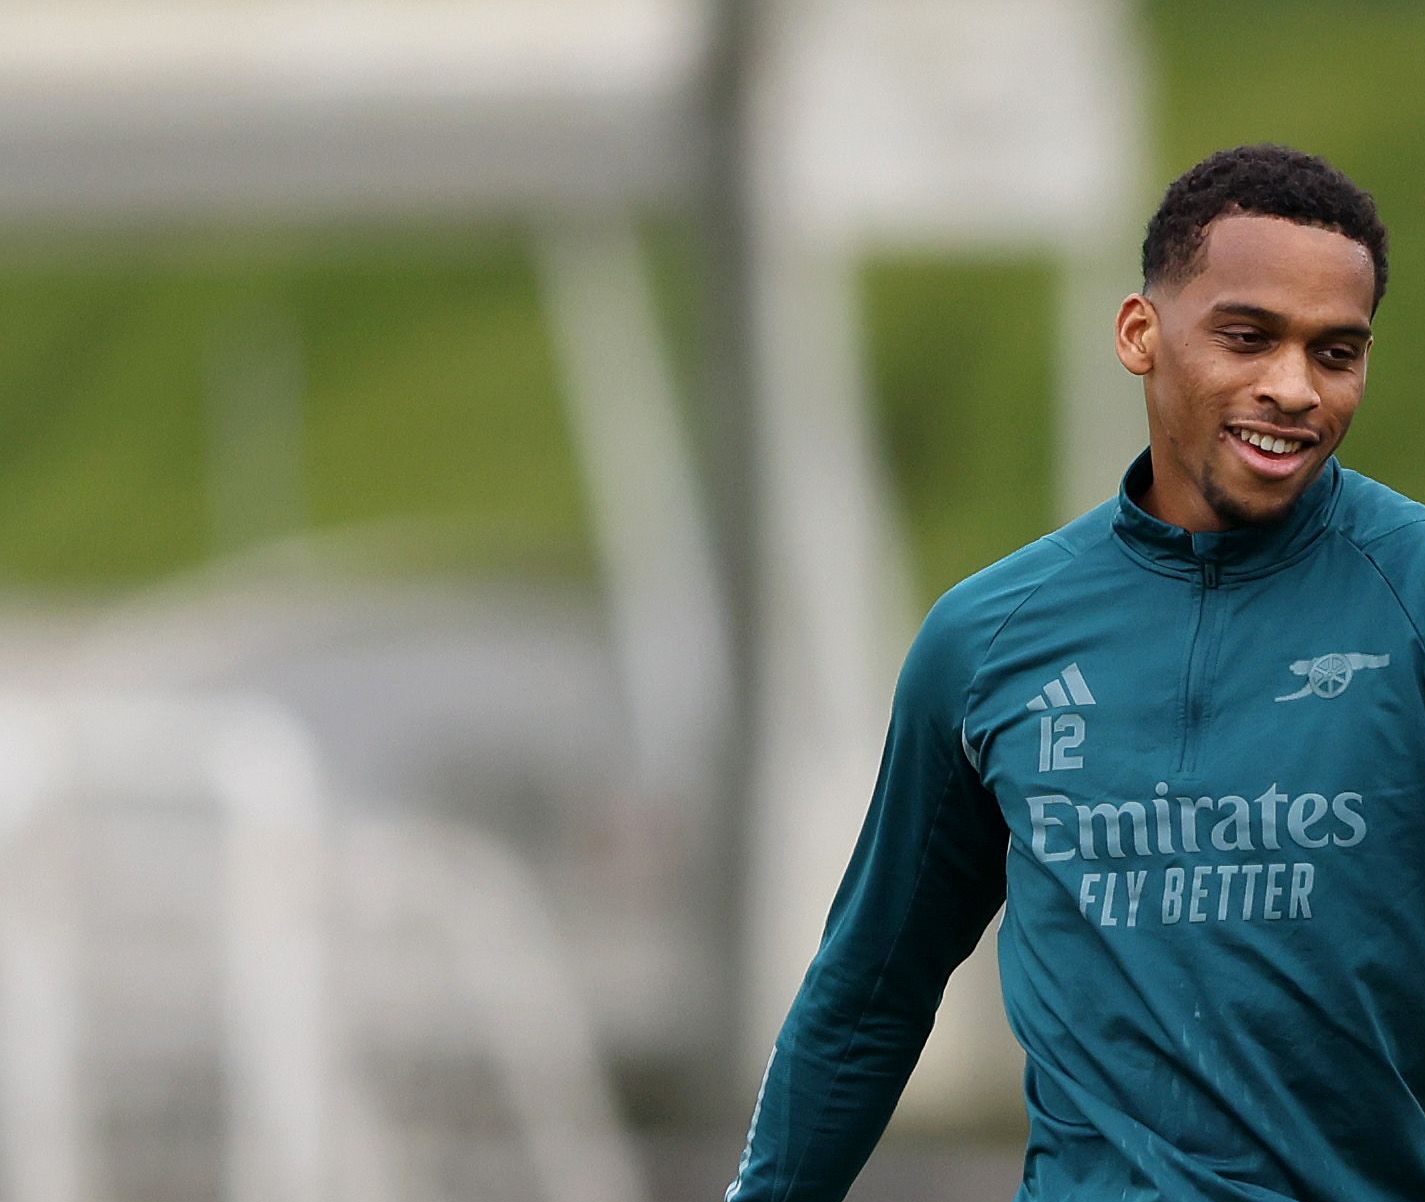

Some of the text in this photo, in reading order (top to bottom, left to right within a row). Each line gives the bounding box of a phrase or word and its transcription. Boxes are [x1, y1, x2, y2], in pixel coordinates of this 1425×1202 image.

[1038, 713, 1086, 773] 12
[1025, 781, 1368, 863] Emirates
[1079, 863, 1315, 927] FLY BETTER
